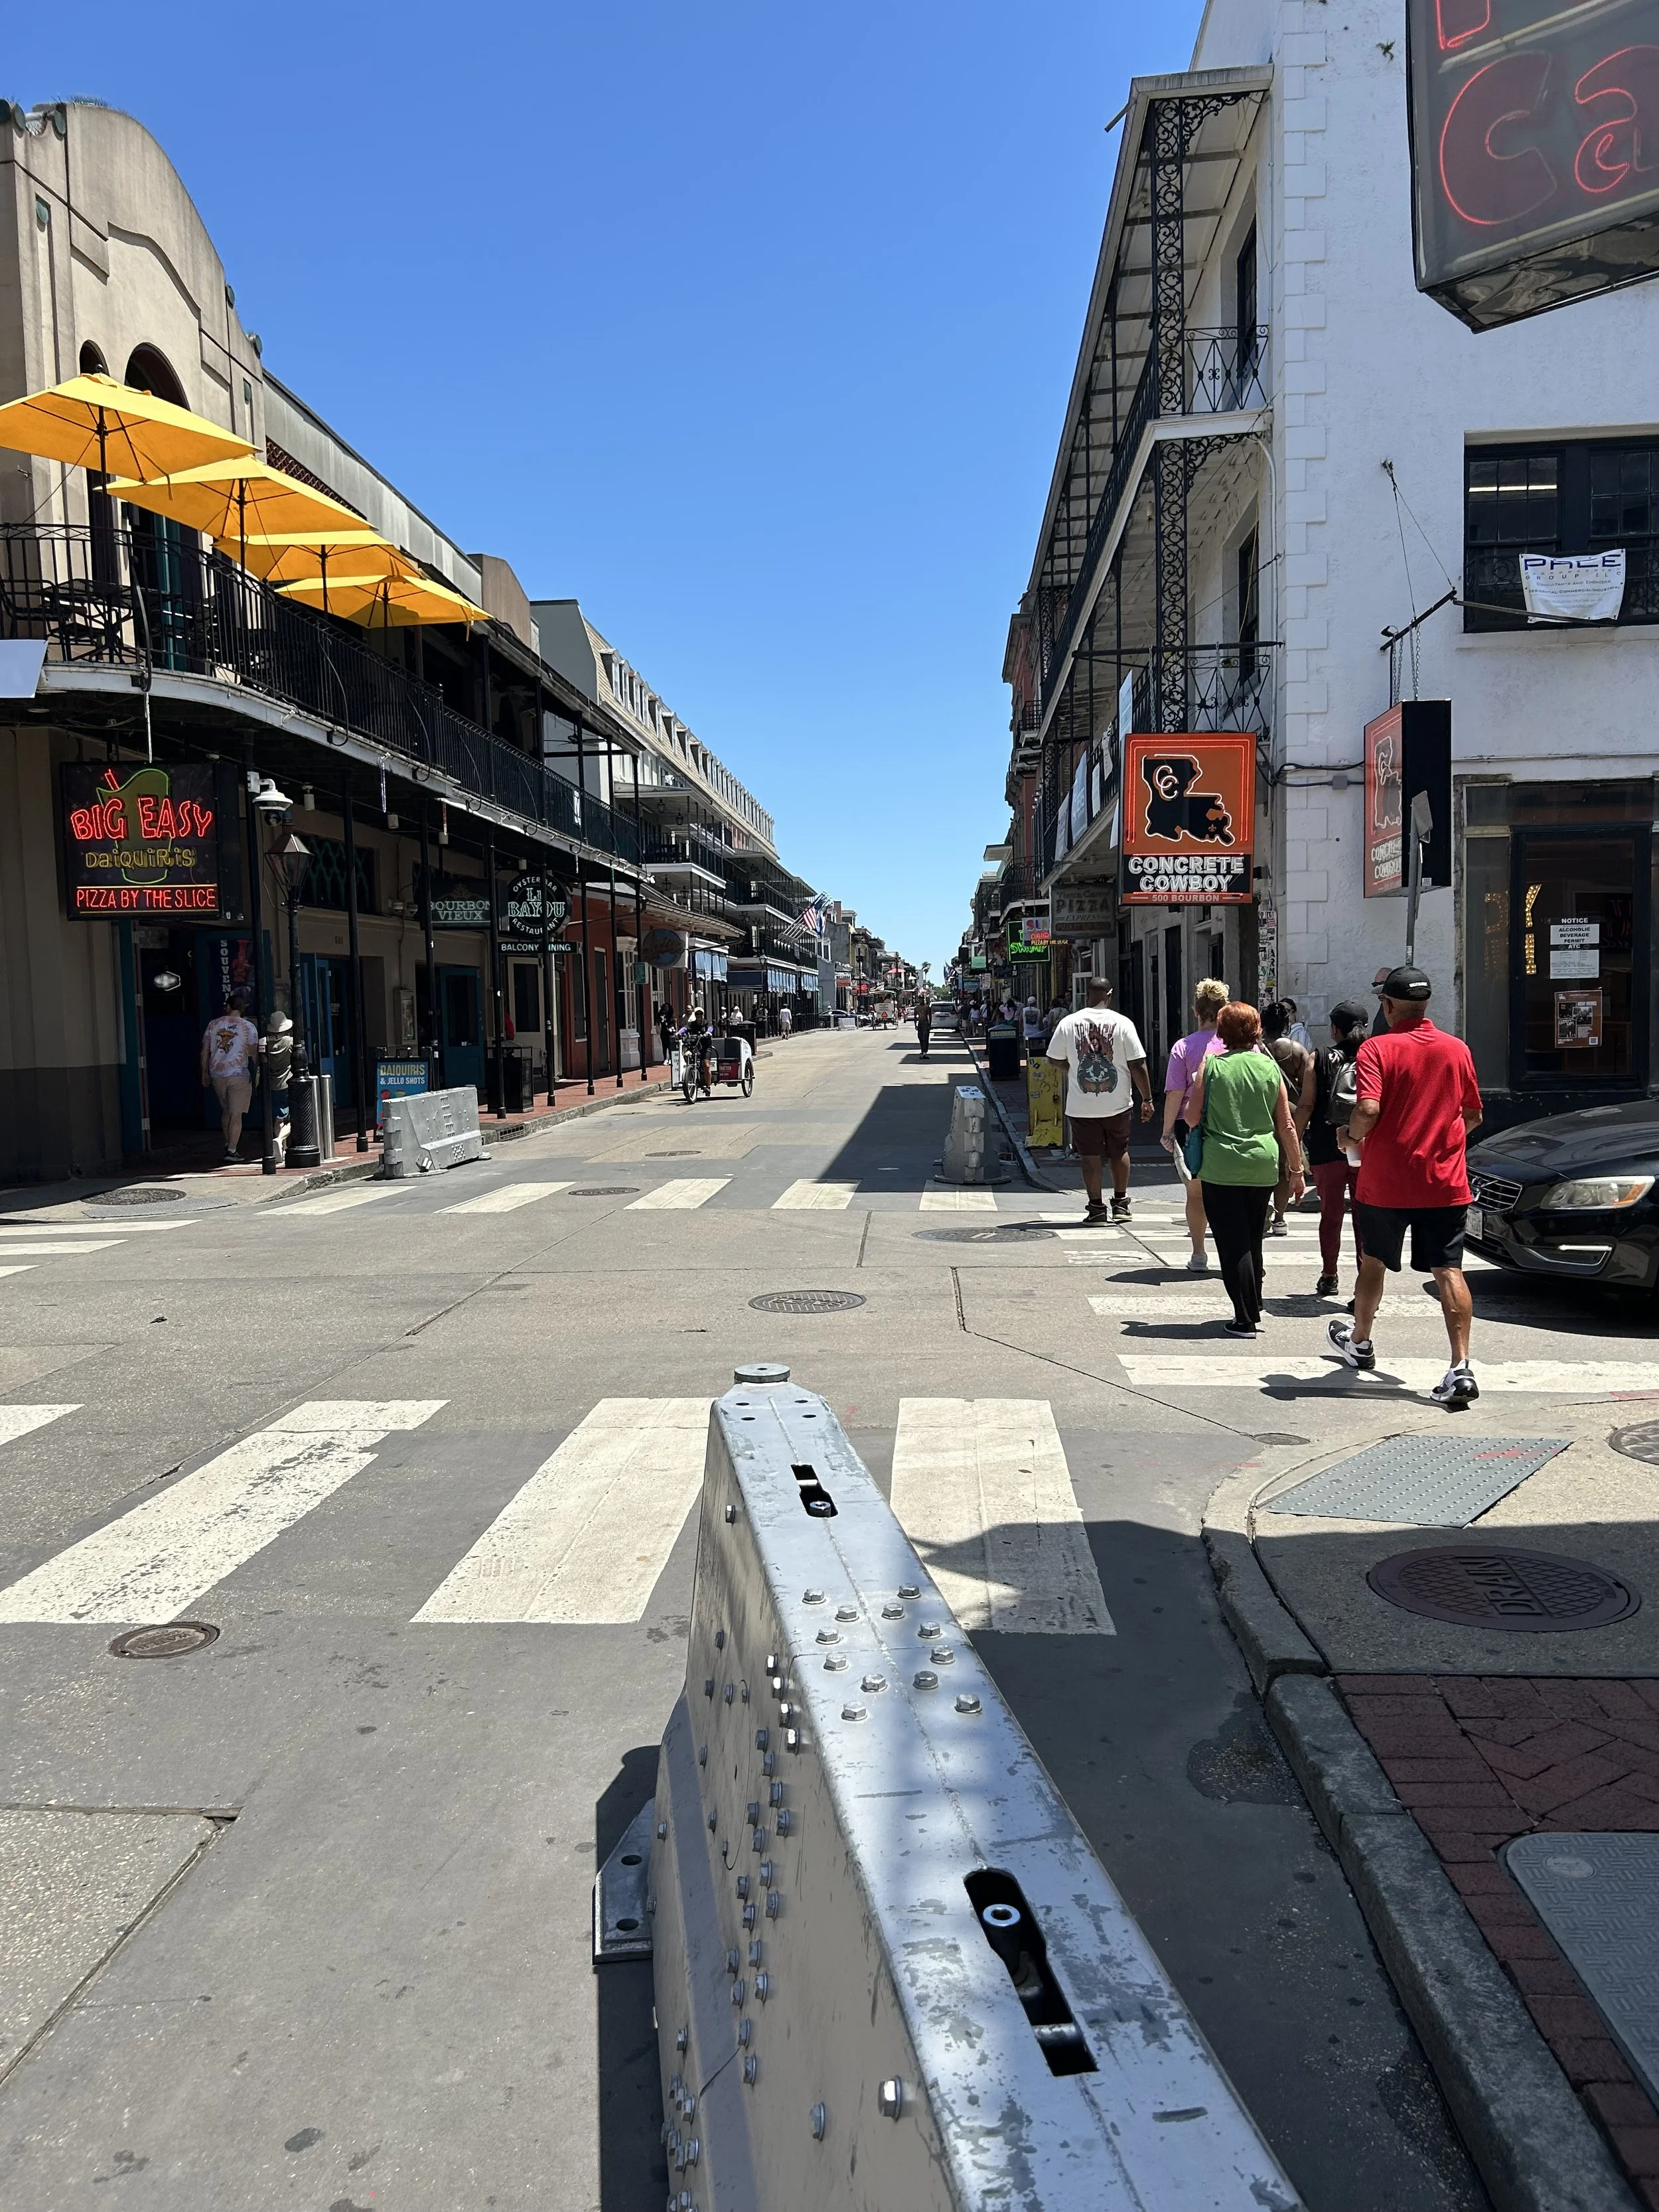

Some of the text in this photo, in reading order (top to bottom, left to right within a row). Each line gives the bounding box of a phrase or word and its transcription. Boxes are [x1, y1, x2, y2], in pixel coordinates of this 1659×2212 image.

[1524, 553, 1621, 571] PACE
[70, 796, 212, 840] BIG EASY
[1128, 856, 1244, 875] CONCRETE
[513, 876, 541, 893] OYSTER
[1139, 875, 1233, 893] COWBOY
[76, 889, 216, 909] PIZZA BY THE SLICE
[1056, 898, 1111, 914] PIZZA
[437, 911, 483, 921] VIEUX
[547, 943, 571, 952] INING
[380, 1065, 425, 1076] DAIQUIRIS
[1455, 1556, 1544, 1615] DRAIN
